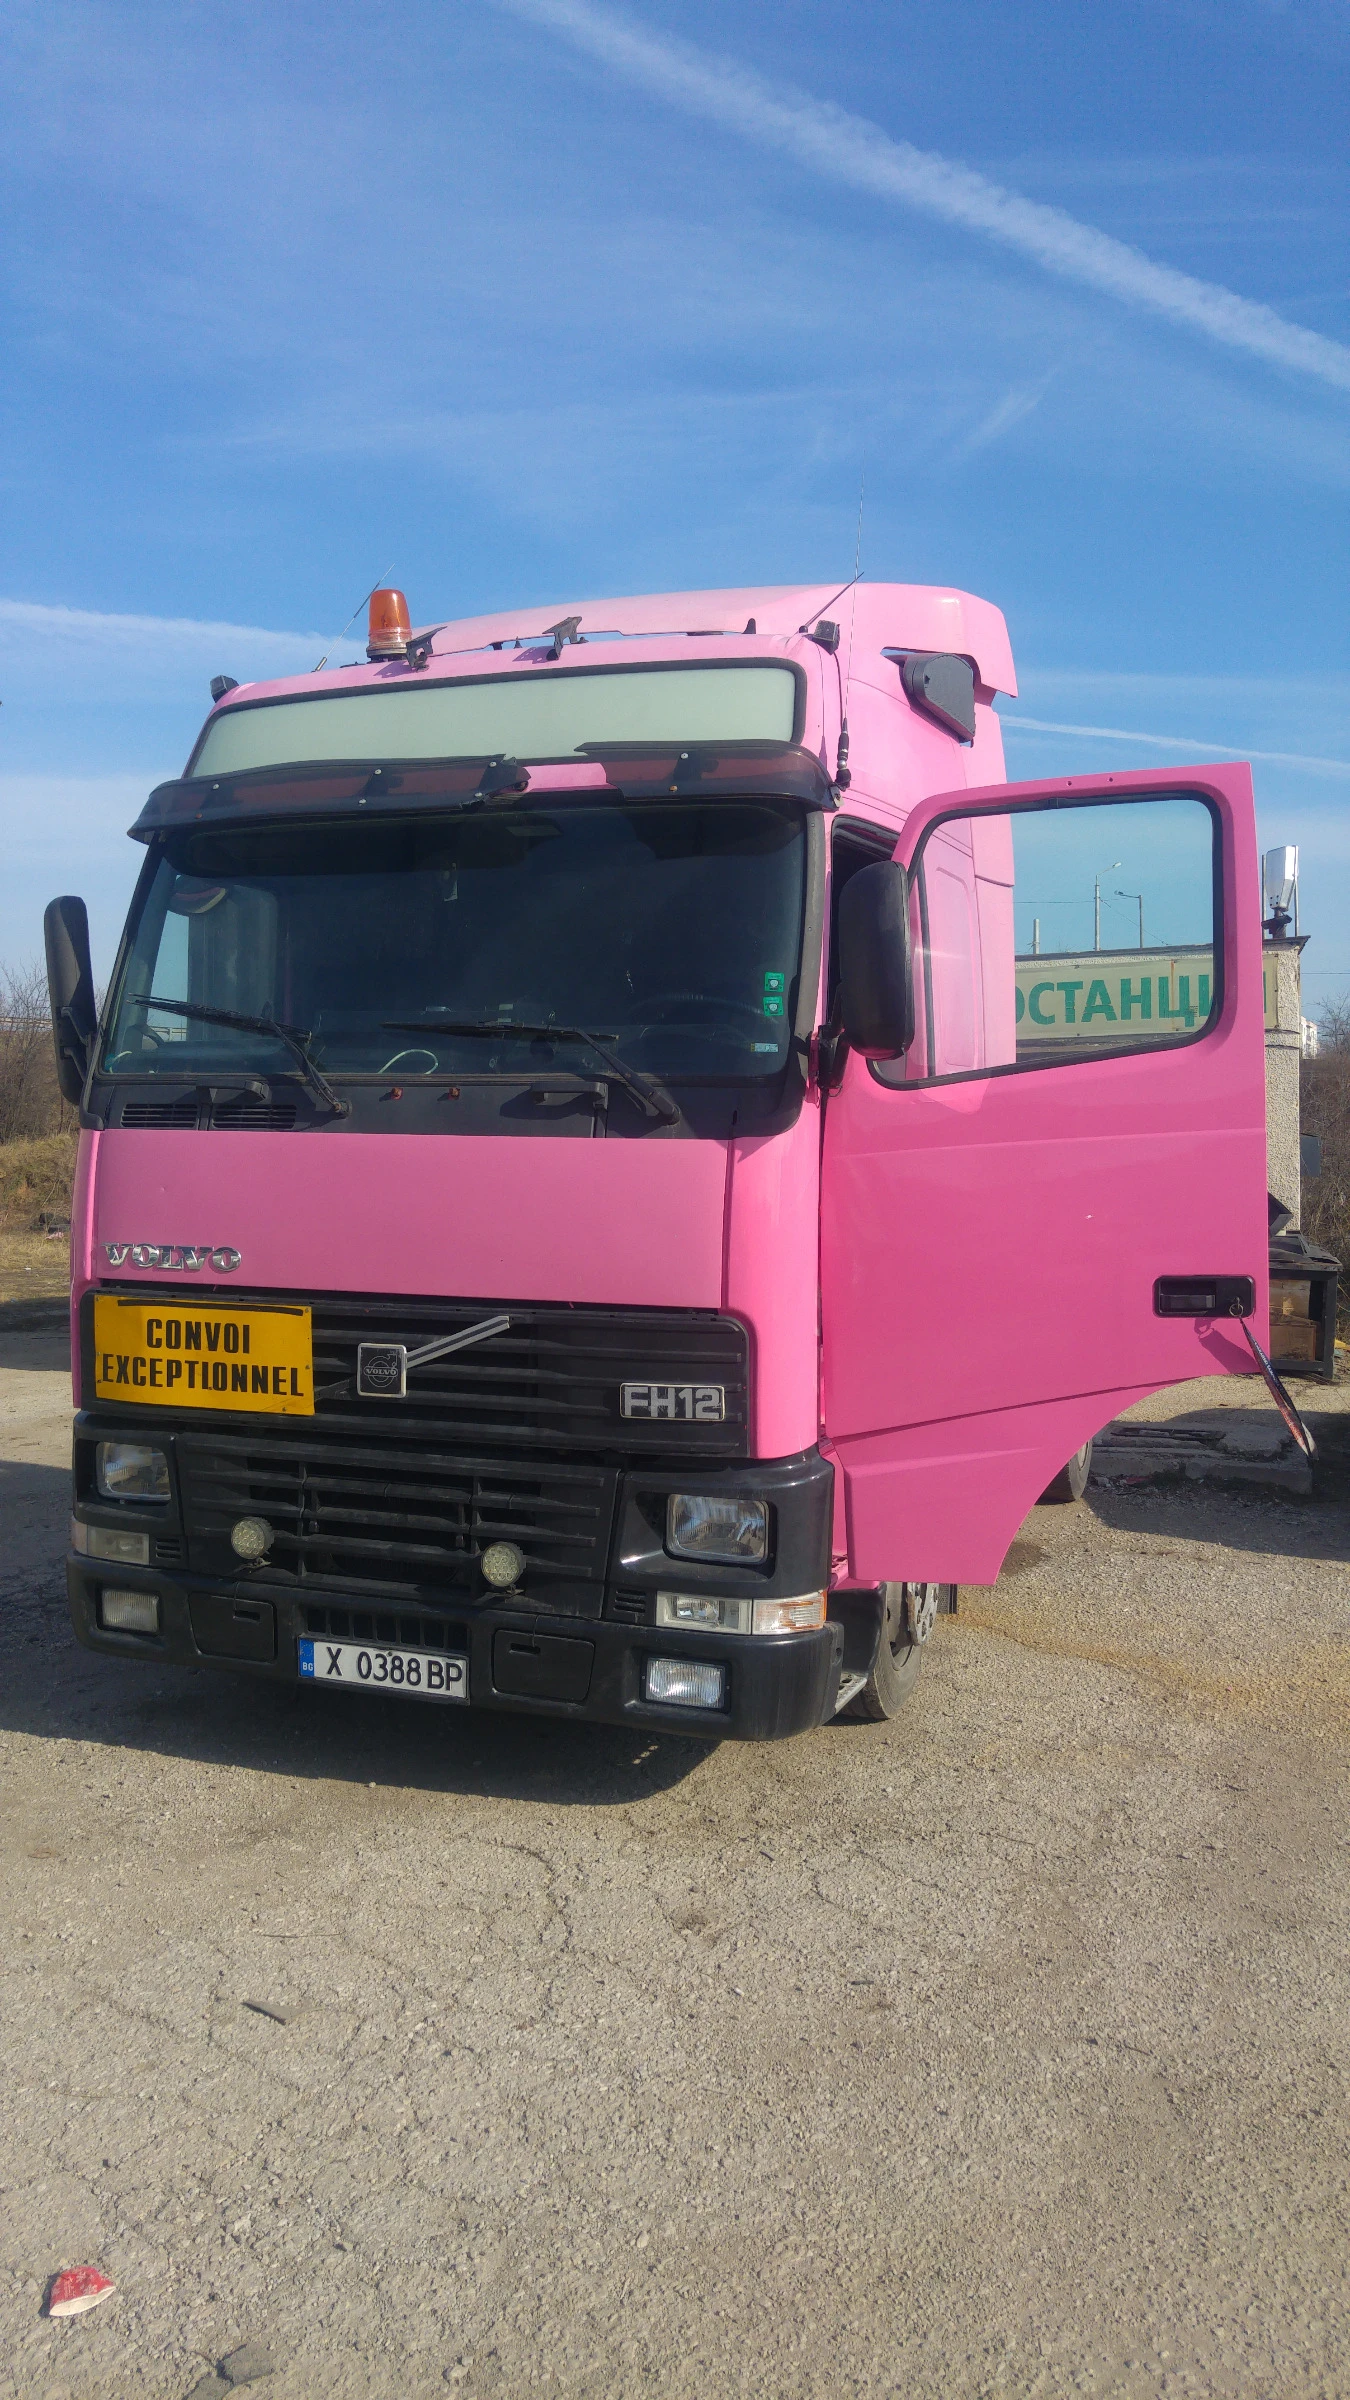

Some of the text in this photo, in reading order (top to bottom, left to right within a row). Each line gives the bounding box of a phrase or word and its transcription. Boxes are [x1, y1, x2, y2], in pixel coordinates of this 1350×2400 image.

[101, 1242, 242, 1272] VOLVO
[146, 1318, 250, 1354] CONVOI
[102, 1353, 304, 1397] EXCEPTIONNEL
[365, 1367, 397, 1375] VOLVO
[624, 1386, 720, 1420] FH12
[302, 1661, 314, 1672] BG
[326, 1646, 343, 1676] X
